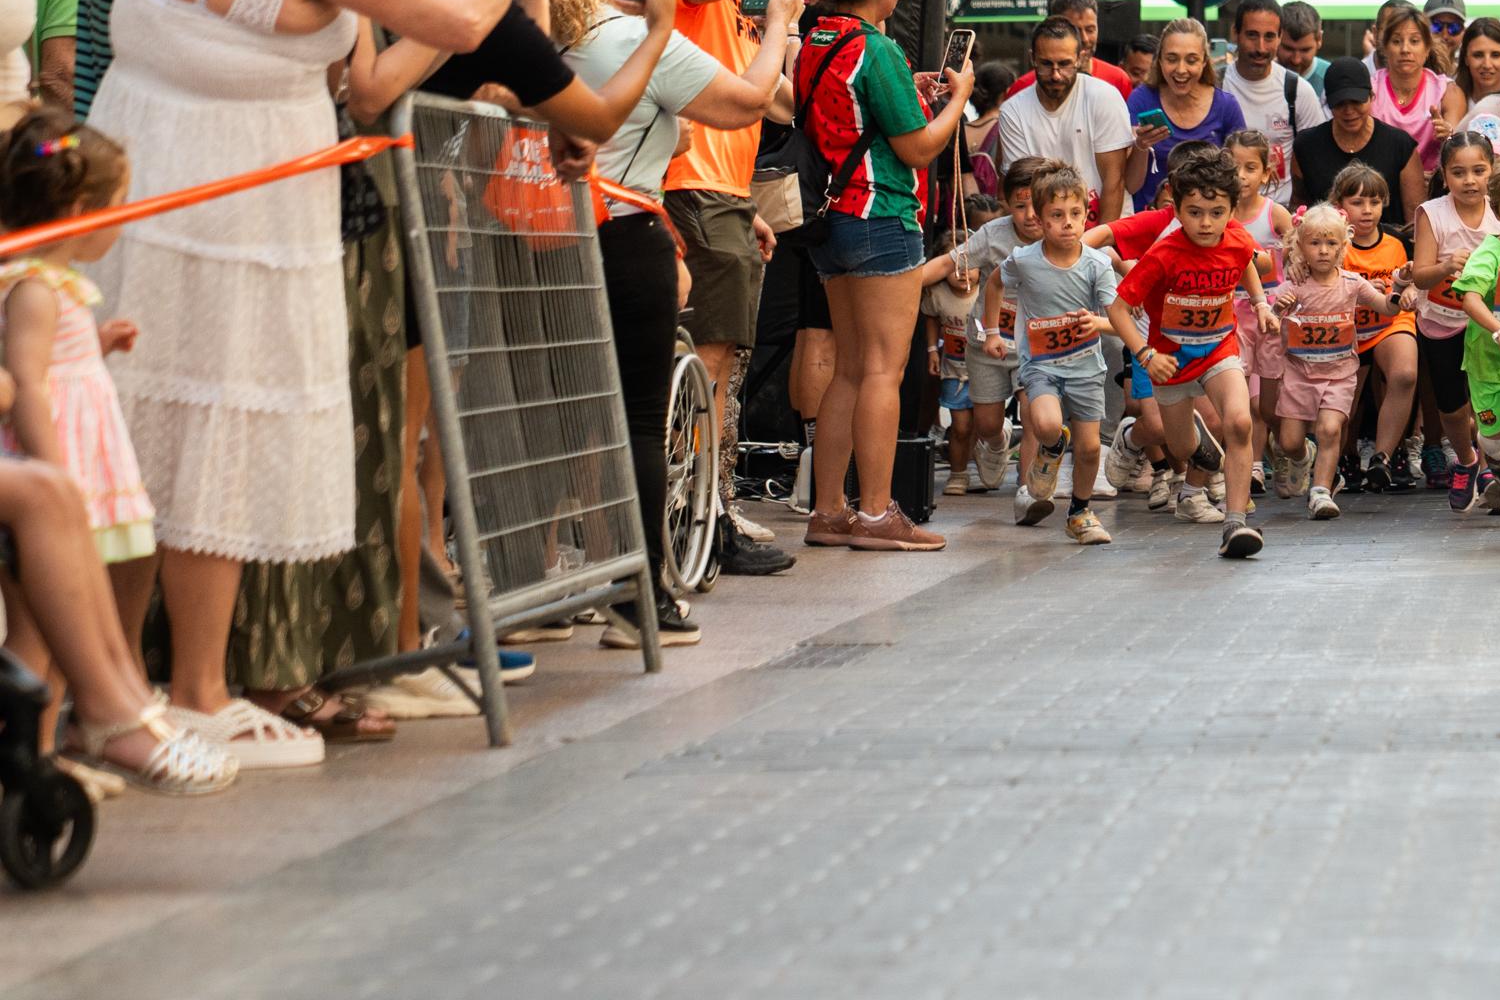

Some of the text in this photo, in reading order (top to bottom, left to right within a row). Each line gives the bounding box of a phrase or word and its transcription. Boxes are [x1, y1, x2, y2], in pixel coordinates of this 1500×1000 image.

[1176, 268, 1241, 289] MARIO
[1178, 308, 1223, 329] 337
[1301, 325, 1340, 345] 322
